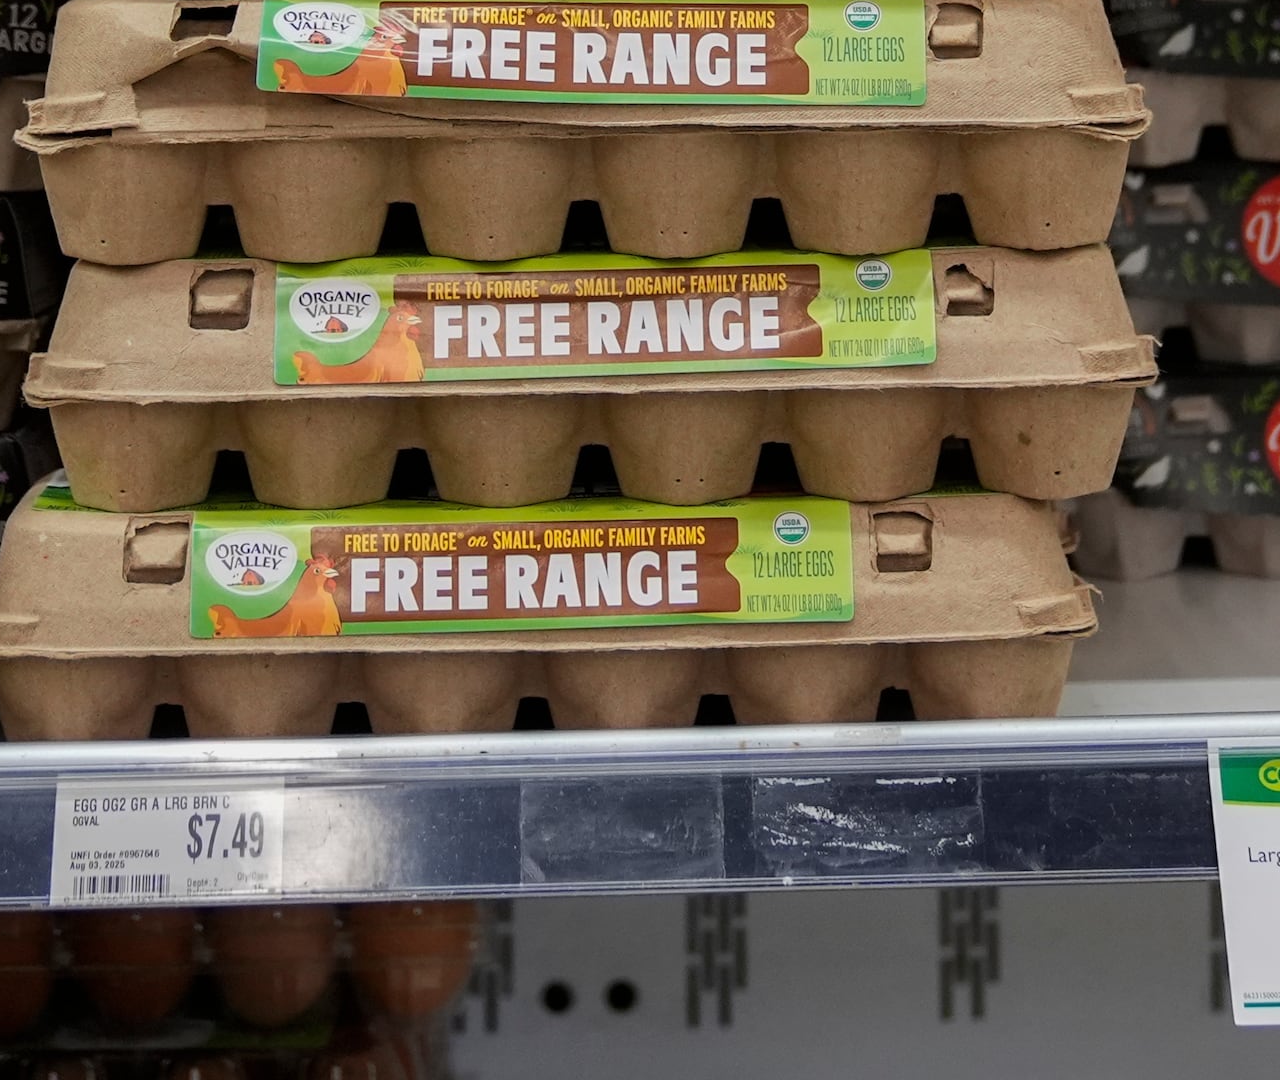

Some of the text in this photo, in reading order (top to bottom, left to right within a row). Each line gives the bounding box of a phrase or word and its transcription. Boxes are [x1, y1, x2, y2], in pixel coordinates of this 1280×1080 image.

[283, 11, 356, 25] ORGANIC
[290, 21, 351, 34] VALLEY
[417, 27, 767, 86] FREE RANGE
[433, 296, 780, 358] FREE RANGE
[345, 533, 378, 553] FREE
[381, 533, 400, 553] TO
[467, 535, 488, 548] on
[492, 529, 541, 552] SMALL,
[544, 527, 604, 548] ORGANIC
[608, 526, 655, 547] FAMILY
[660, 525, 705, 546] FARMS
[215, 543, 288, 559] ORGANIC
[221, 555, 282, 570] VALLEY
[752, 550, 835, 578] 12 LARGE EGGS
[350, 549, 698, 613] FREE RANGE
[747, 594, 759, 613] NET
[74, 798, 97, 813] EGG
[131, 796, 148, 811] GR
[152, 796, 160, 810] A
[164, 796, 188, 810] LRG
[193, 795, 218, 810] BRN
[73, 816, 100, 827] OGVAL
[186, 811, 265, 864] $7.49
[70, 850, 91, 860] UNFI
[95, 850, 116, 859] Order
[70, 862, 86, 871] Aug
[105, 860, 125, 869] 2025
